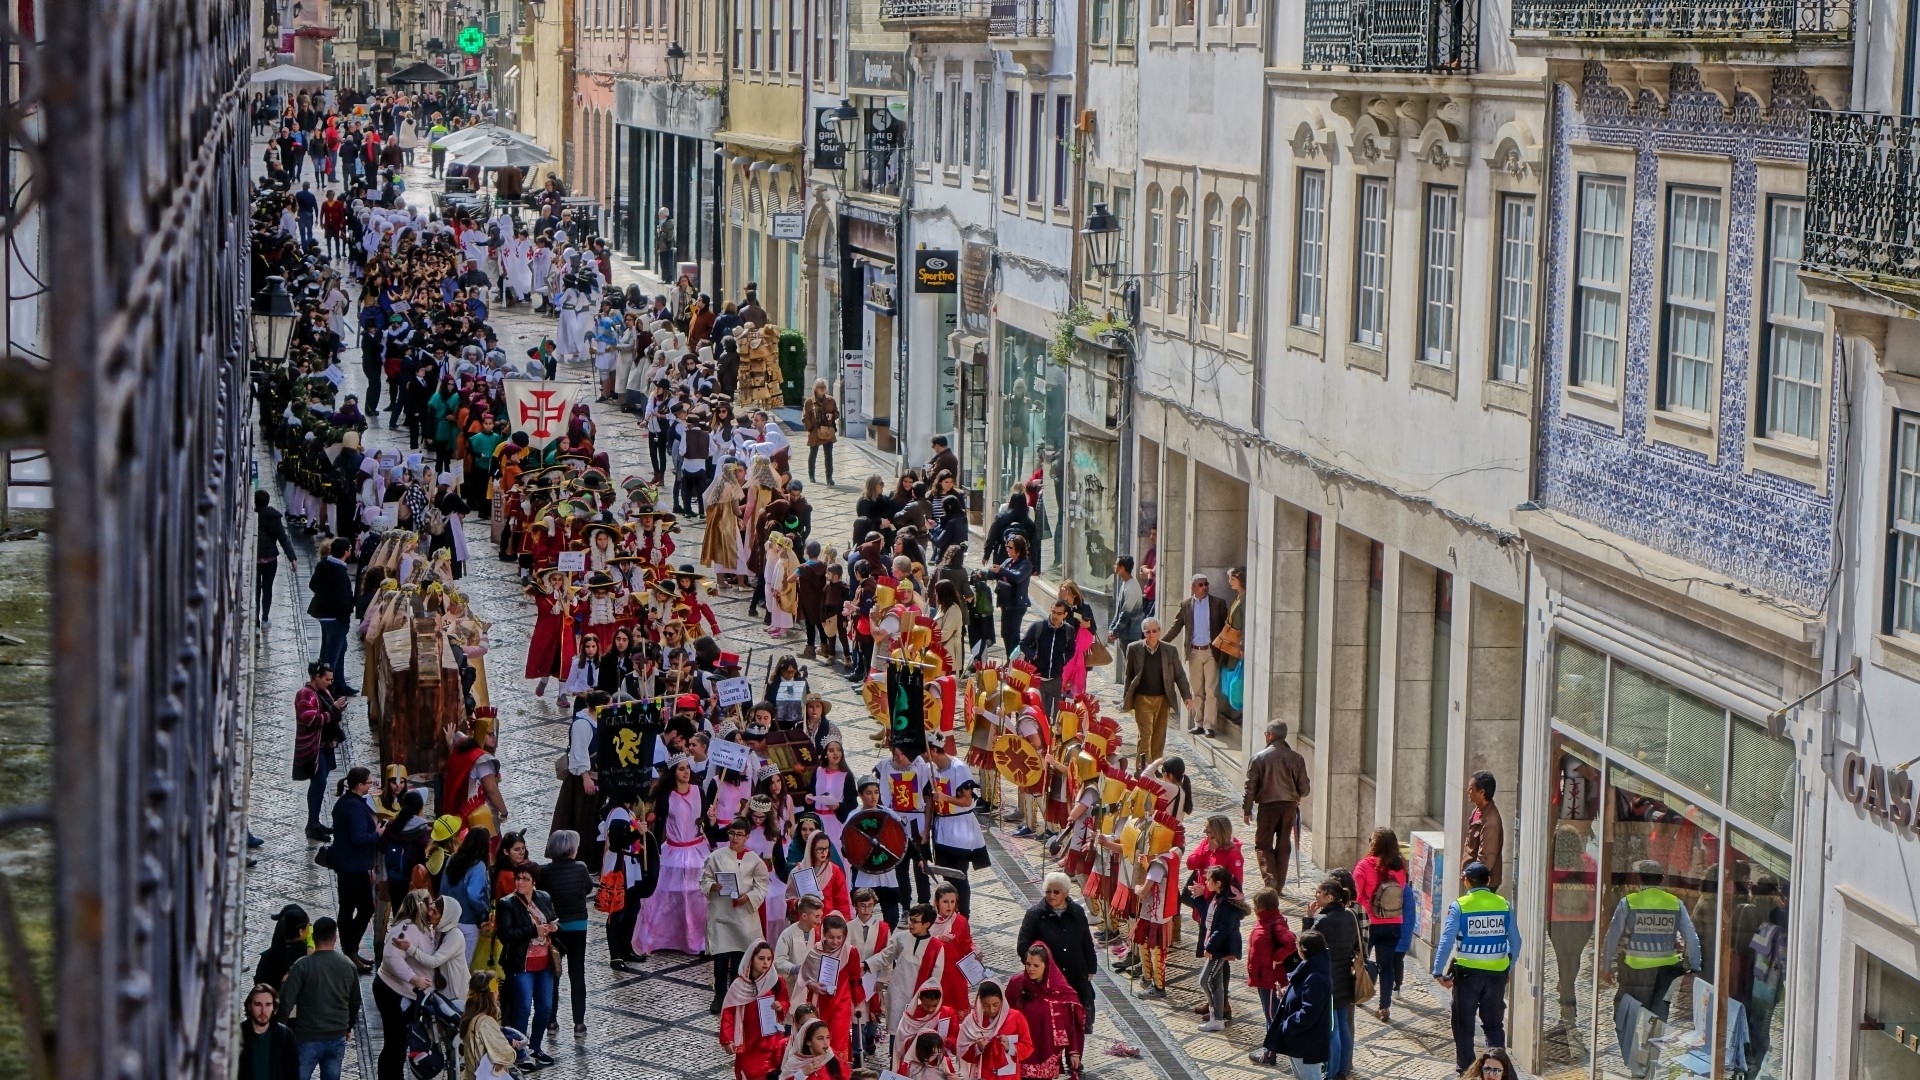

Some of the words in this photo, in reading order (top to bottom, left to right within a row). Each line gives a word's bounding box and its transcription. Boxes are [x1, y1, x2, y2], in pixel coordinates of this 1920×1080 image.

[819, 142, 840, 152] four
[918, 268, 955, 283] Sportino
[1468, 917, 1505, 929] POLÍCIA
